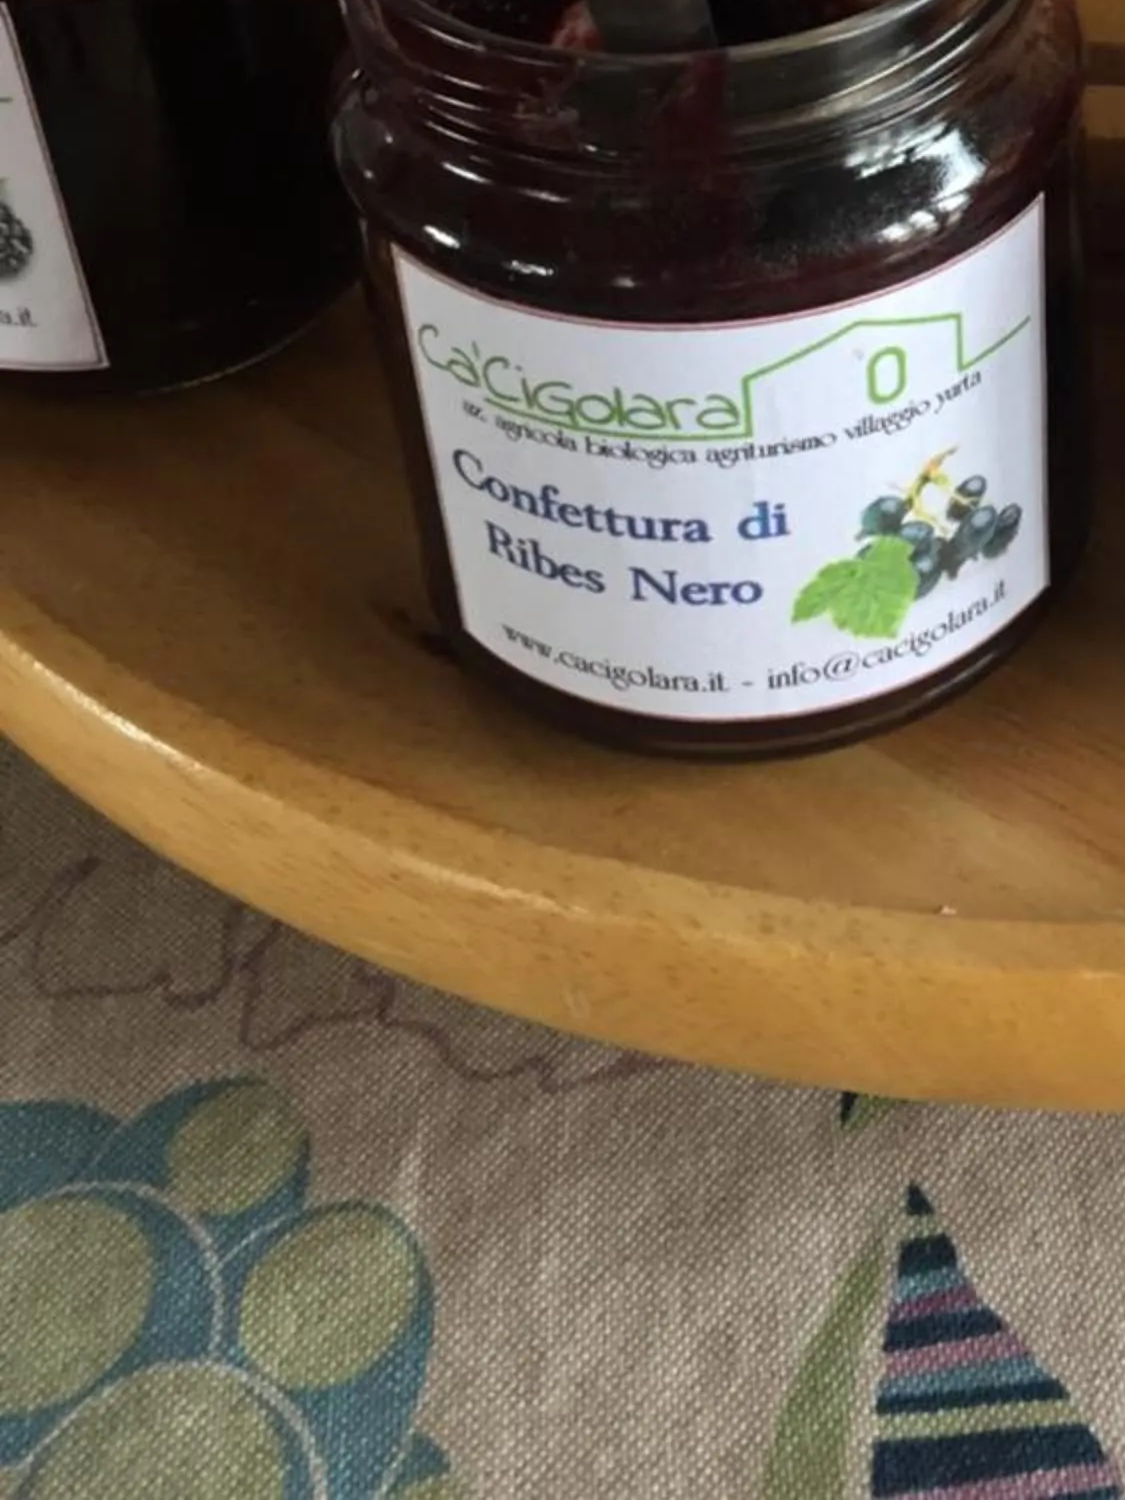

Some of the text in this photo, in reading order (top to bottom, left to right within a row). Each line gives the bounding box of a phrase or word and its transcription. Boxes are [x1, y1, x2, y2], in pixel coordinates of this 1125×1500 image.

[494, 413, 579, 453] agricola
[584, 435, 698, 470] biologica
[704, 431, 838, 469] agriturismo
[844, 398, 933, 439] villaggio
[931, 369, 983, 415] yurta
[451, 448, 792, 544] Confettura di
[484, 518, 764, 607] Ribes Nero
[501, 622, 729, 693] www.cacigolara.it
[766, 577, 1008, 692] info@cacigolara.it
